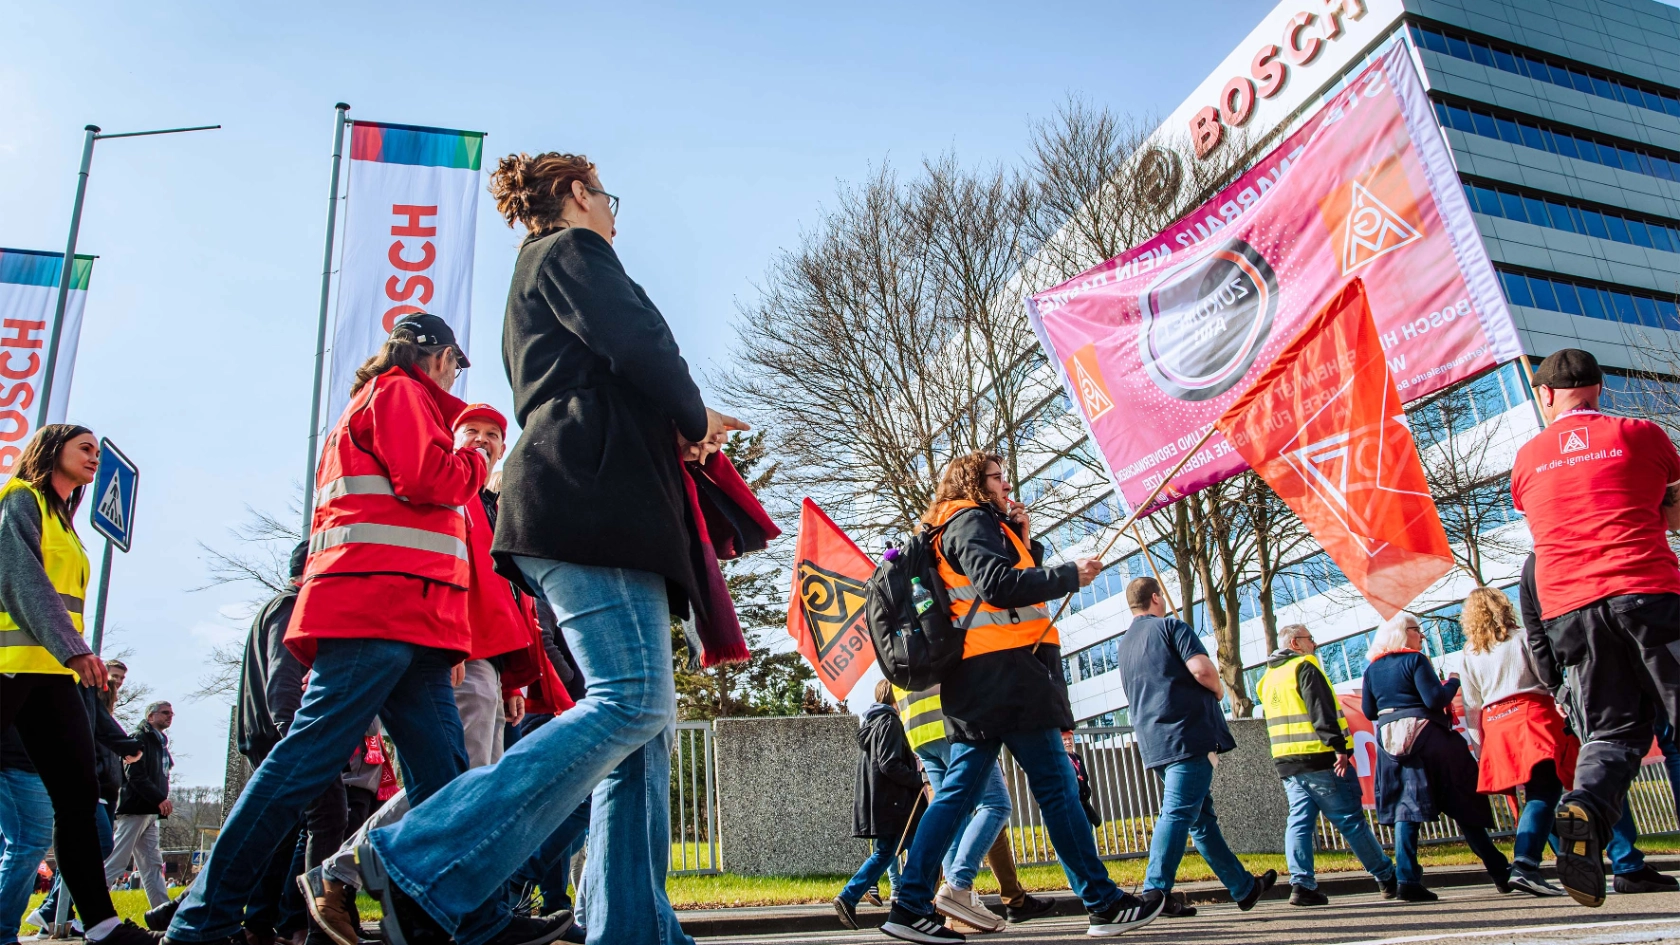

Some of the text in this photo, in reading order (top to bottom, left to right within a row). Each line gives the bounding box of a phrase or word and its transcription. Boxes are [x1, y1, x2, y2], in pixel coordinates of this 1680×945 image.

[1189, 0, 1366, 160] BOSCH
[382, 203, 438, 336] OSCH
[1535, 448, 1623, 474] wir.die-igmetall.de
